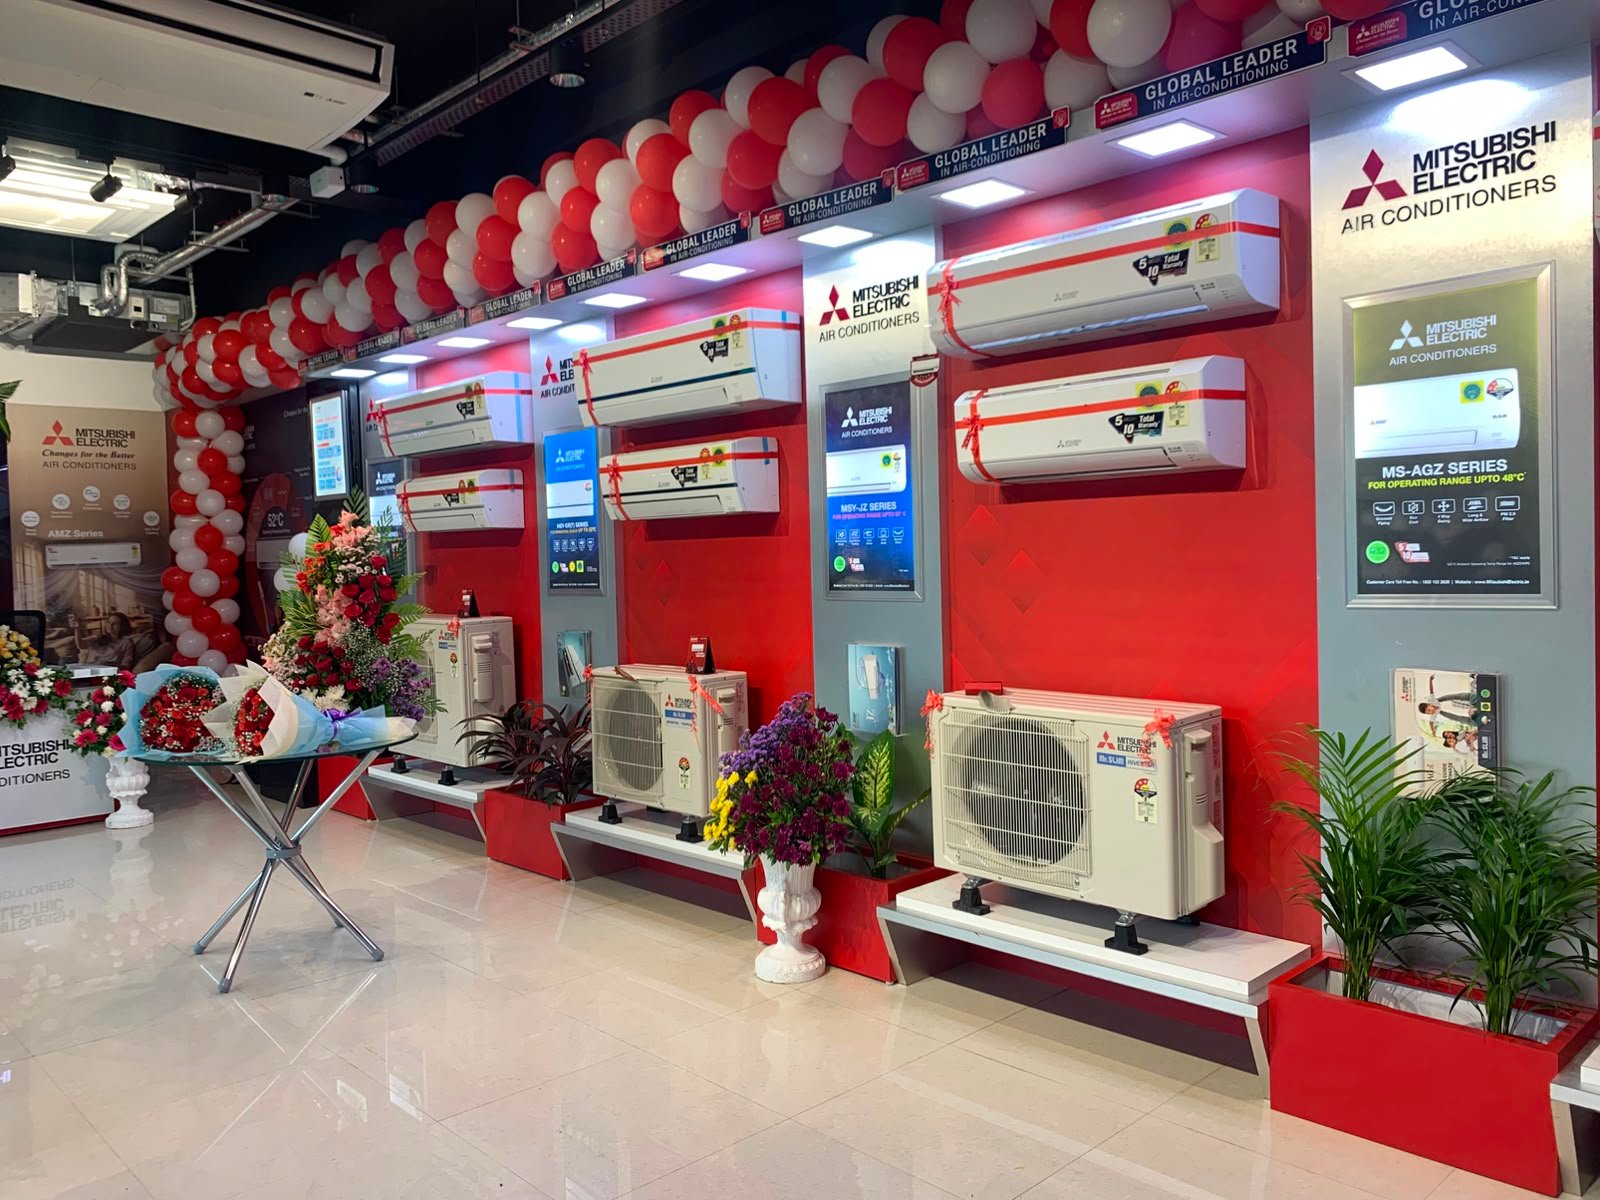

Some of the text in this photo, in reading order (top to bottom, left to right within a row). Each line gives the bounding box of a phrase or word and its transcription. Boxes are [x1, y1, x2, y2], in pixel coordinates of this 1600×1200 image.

[1429, 16, 1446, 30] IN
[1145, 38, 1298, 100] GLOBAL LEADER
[1153, 99, 1165, 111] IN
[1169, 59, 1289, 108] AIR-CONDITIONING
[935, 123, 1046, 168] GLOBAL LEADER
[1413, 121, 1556, 173] MITSUBISHI
[940, 167, 950, 178] IN
[953, 140, 1040, 174] AIR-CONDITIONING
[1413, 150, 1536, 194] ELECTRIC
[788, 182, 876, 216] GLOBAL LEADER
[1341, 175, 1557, 235] AIR CONDITIONERS
[794, 216, 801, 226] IN
[803, 196, 872, 223] AIR-CONDITIONING
[666, 223, 736, 254] GLOBAL LEADER
[1138, 258, 1148, 270] 5
[1164, 253, 1180, 264] Total
[568, 259, 626, 286] GLOBAL LEADER
[1148, 266, 1159, 277] 10
[852, 275, 918, 304] MITSUBISHI
[486, 290, 532, 312] GLOBAL LEADER
[853, 293, 910, 318] ELECTRIC
[437, 314, 457, 327] LEADER
[819, 312, 920, 342] AIR CONDITIONERS
[1426, 314, 1496, 335] MITSUBISHI
[1426, 327, 1488, 346] ELECTRIC
[1389, 344, 1496, 366] AIR CONDITIONERS
[540, 389, 552, 398] AIR
[858, 406, 892, 418] MITSUBISHI
[858, 414, 888, 426] ELECTRIC
[1115, 414, 1123, 426] 5
[1140, 414, 1155, 422] Total
[76, 428, 136, 440] MITSUBISHI
[841, 426, 892, 438] AIR CONDITIONERS
[1123, 423, 1134, 434] 10
[76, 438, 128, 448] ELECTRIC
[42, 449, 78, 458] Changes
[110, 451, 136, 459] Better
[43, 461, 137, 471] AIR CONDITIONERS
[1382, 458, 1508, 479] MS-AGZ SERIES
[1368, 481, 1386, 490] FOR
[1388, 478, 1438, 488] OPERATING
[1440, 476, 1472, 486] RANGE
[1474, 474, 1500, 484] UPTO
[841, 501, 896, 512] MSY-JZ SERIES
[48, 530, 71, 538] AMZ
